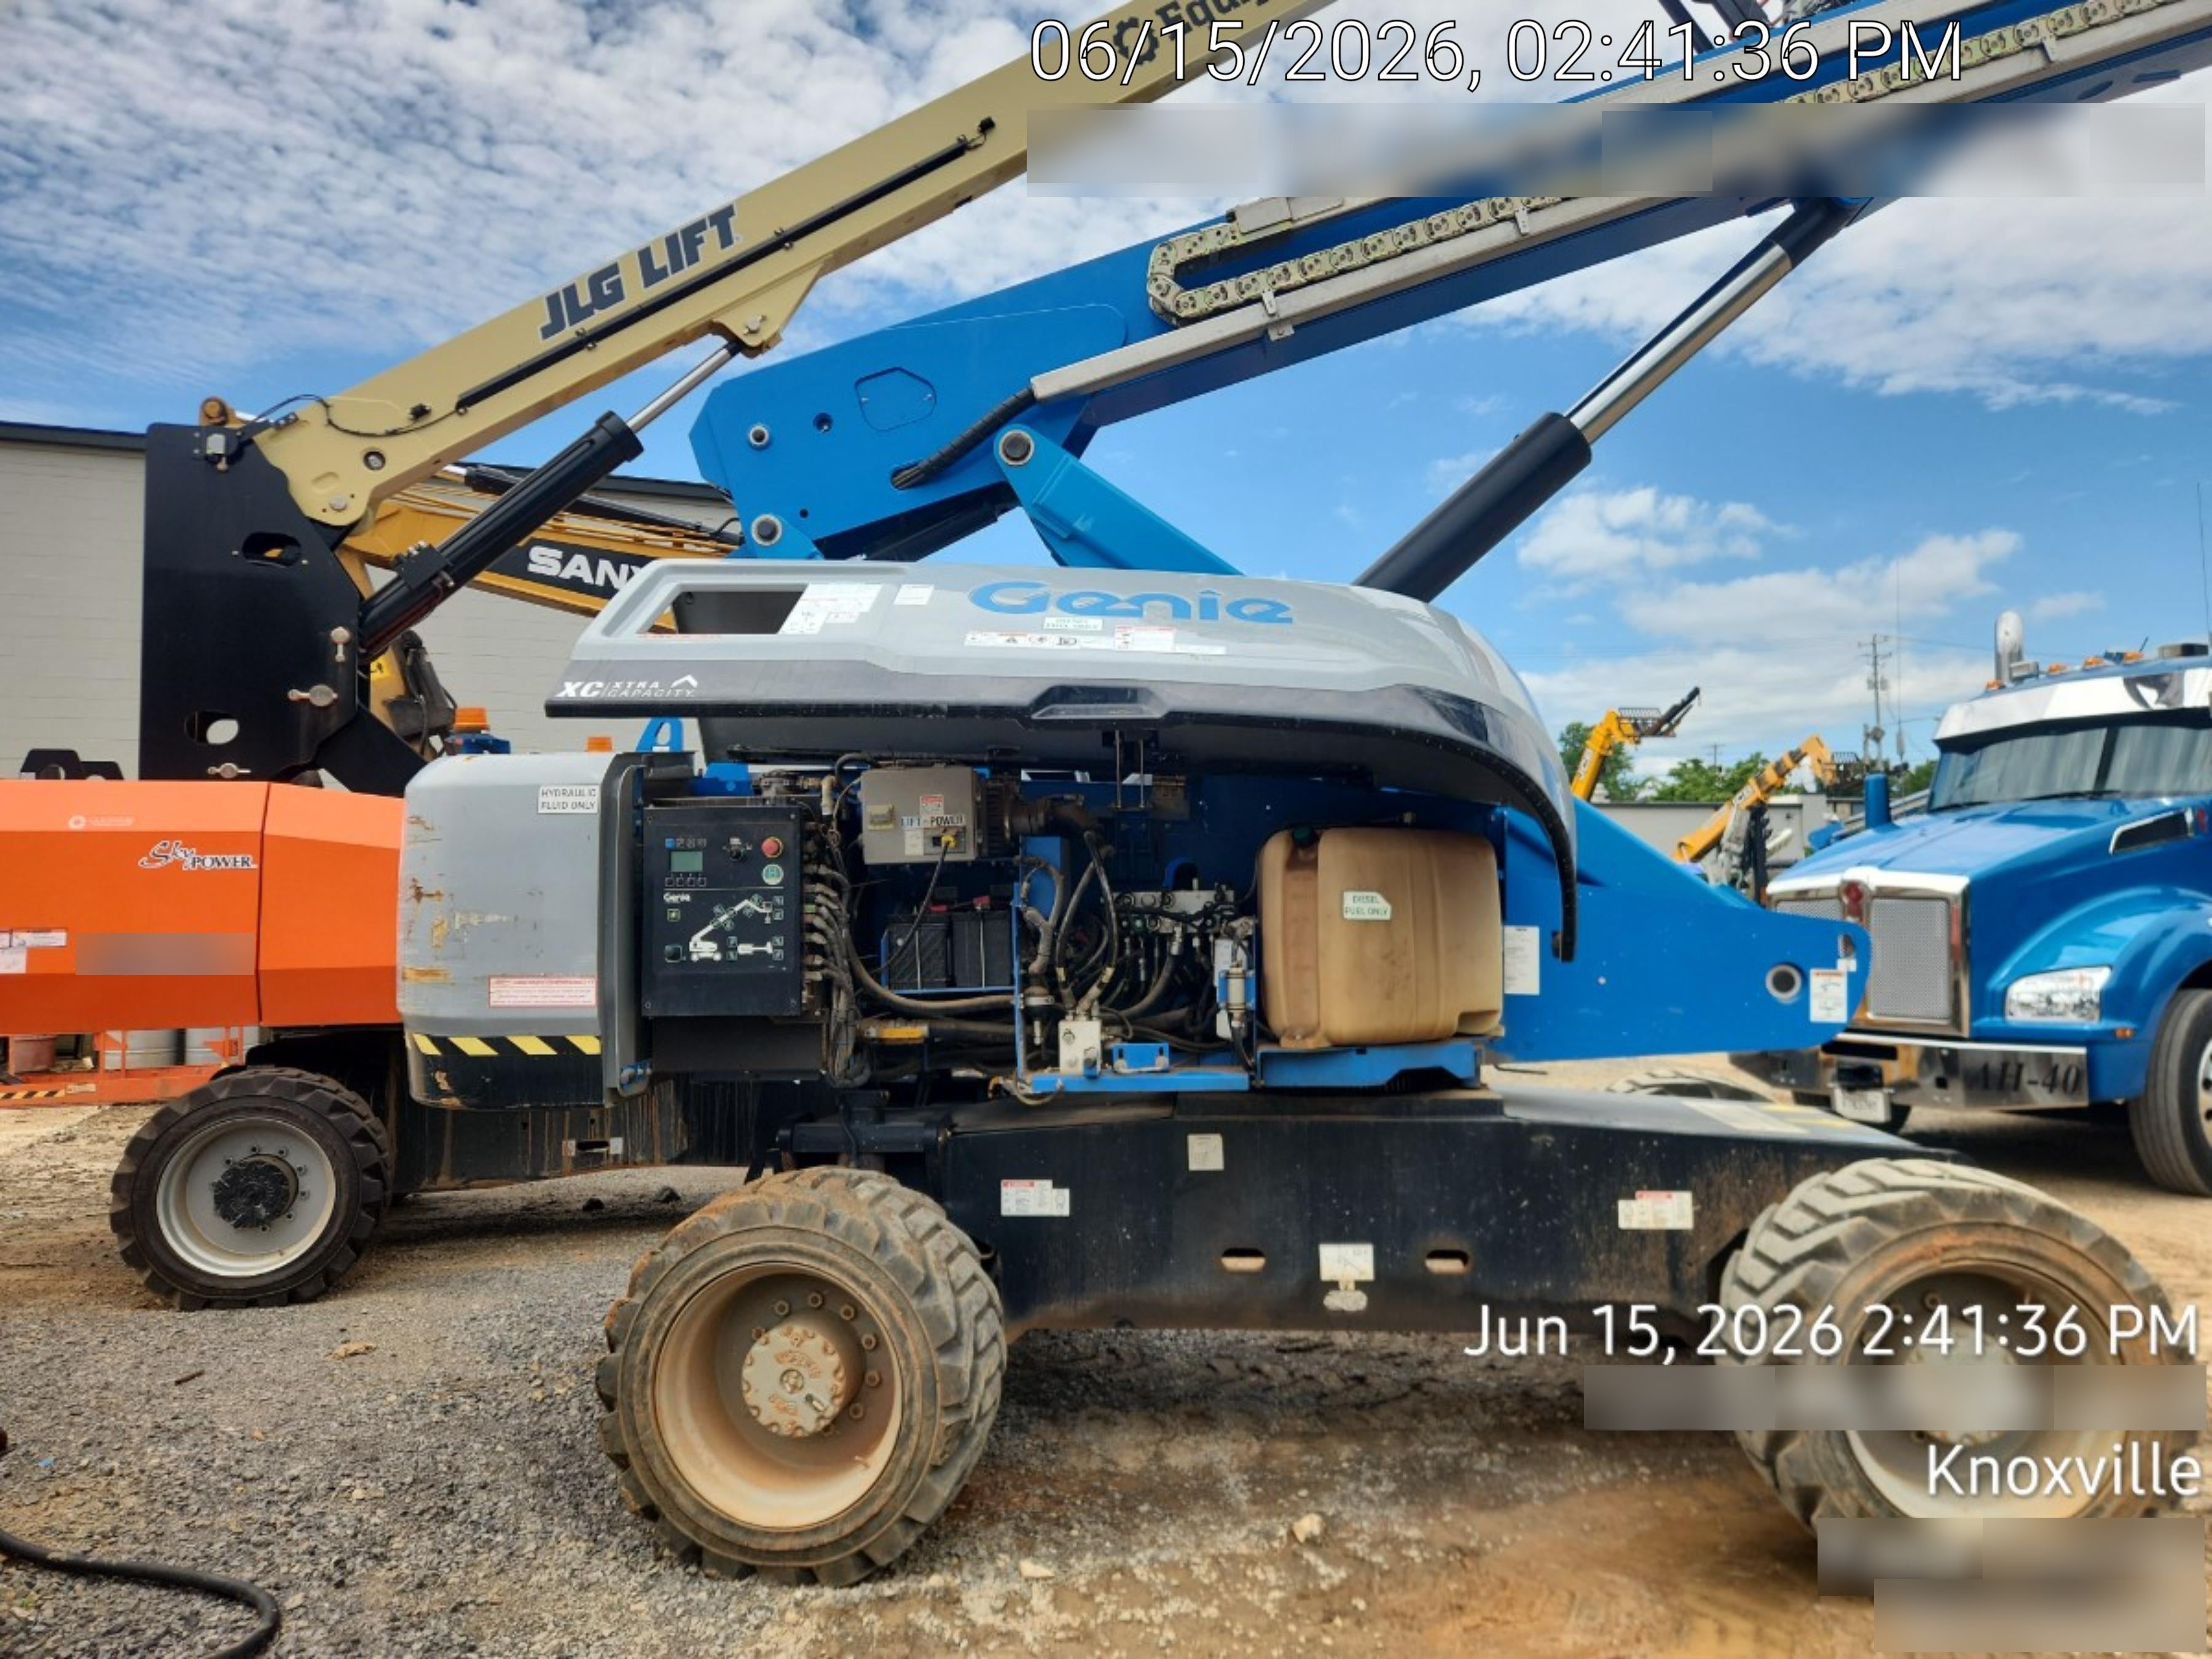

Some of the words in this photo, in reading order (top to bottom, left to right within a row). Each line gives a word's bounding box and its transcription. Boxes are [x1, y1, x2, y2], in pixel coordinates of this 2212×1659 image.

[539, 261, 626, 340] JLG
[637, 204, 736, 289] LIFT
[527, 546, 642, 590] SAN
[969, 581, 1293, 624] Genie
[555, 681, 605, 698] XC
[541, 788, 597, 797] HYDRAULIC
[570, 801, 596, 810] ONLY
